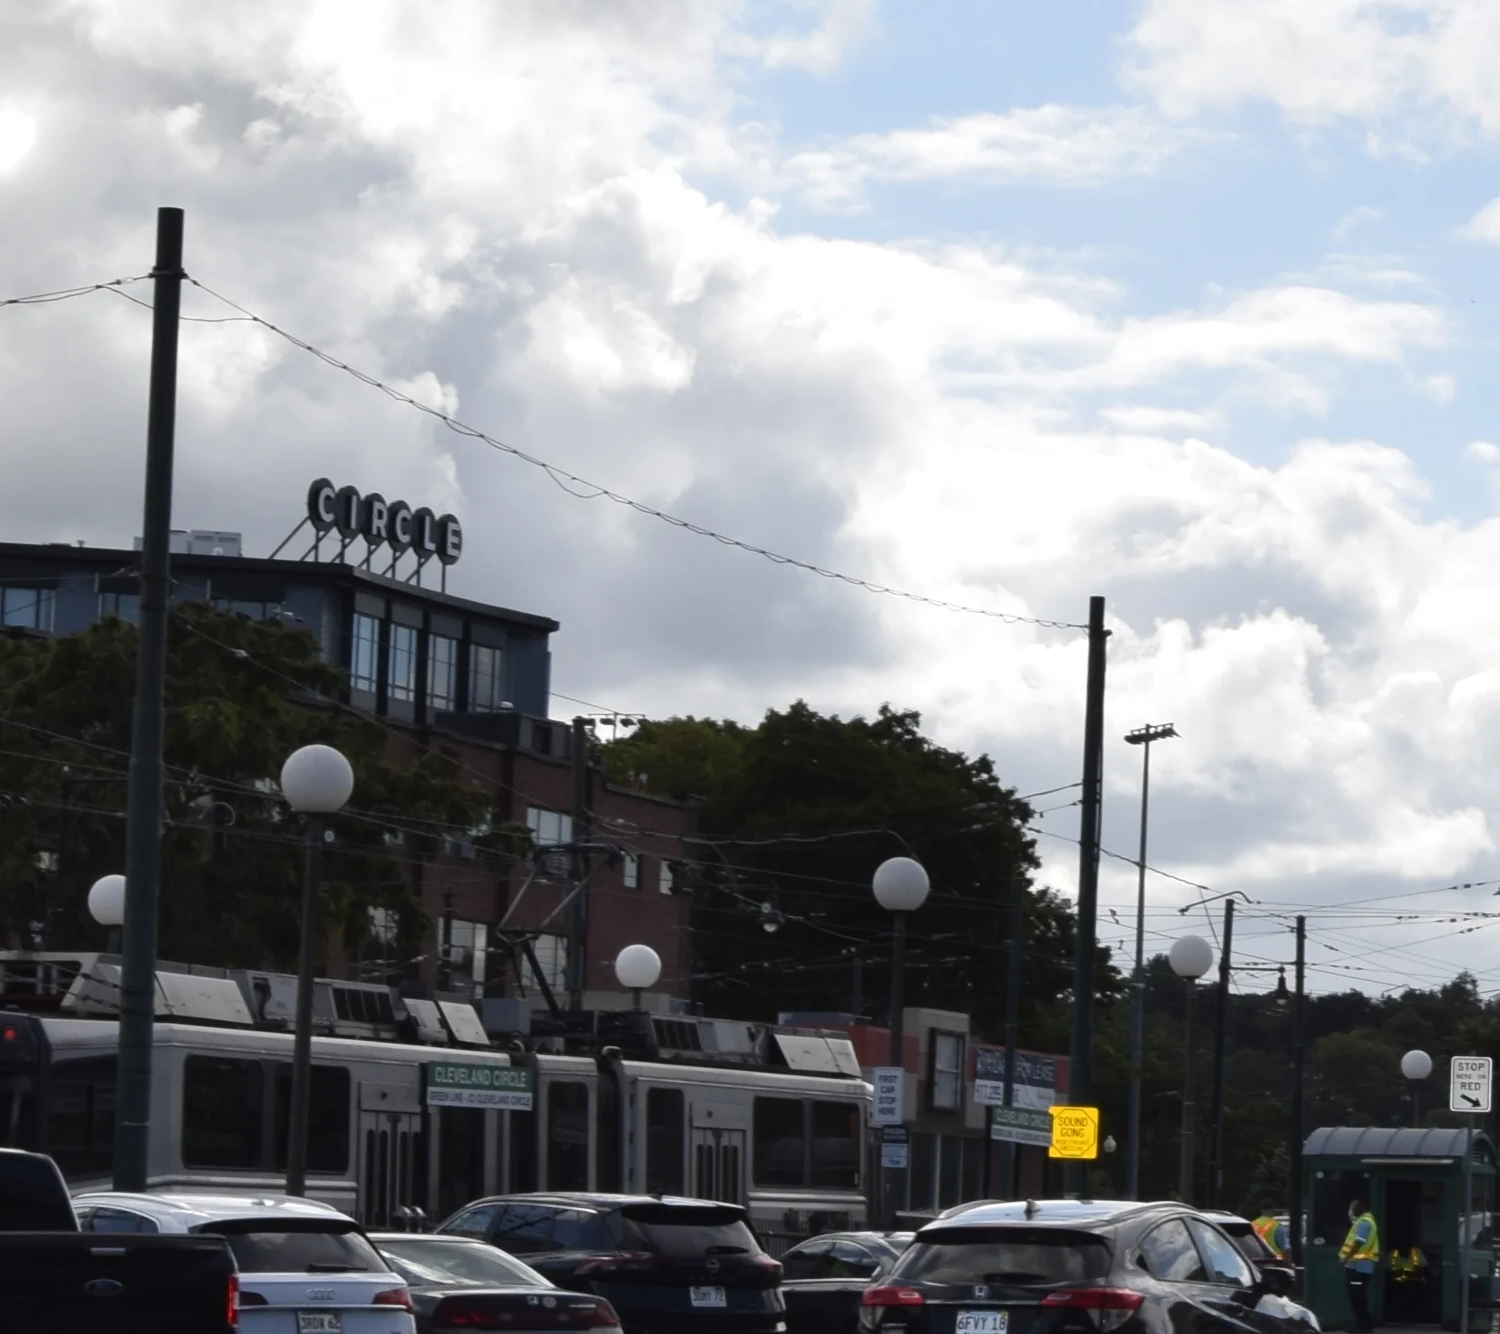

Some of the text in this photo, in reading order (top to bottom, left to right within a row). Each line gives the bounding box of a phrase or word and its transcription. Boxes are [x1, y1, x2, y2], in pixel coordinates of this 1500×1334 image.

[316, 485, 462, 558] CIRCLE
[1457, 1062, 1486, 1072] STOP
[434, 1066, 528, 1088] CLEVELAND CIRCLE
[1460, 1081, 1482, 1091] RED
[1057, 1116, 1089, 1127] SOUND
[1060, 1127, 1086, 1138] GONG
[957, 1316, 989, 1331] 6FVY
